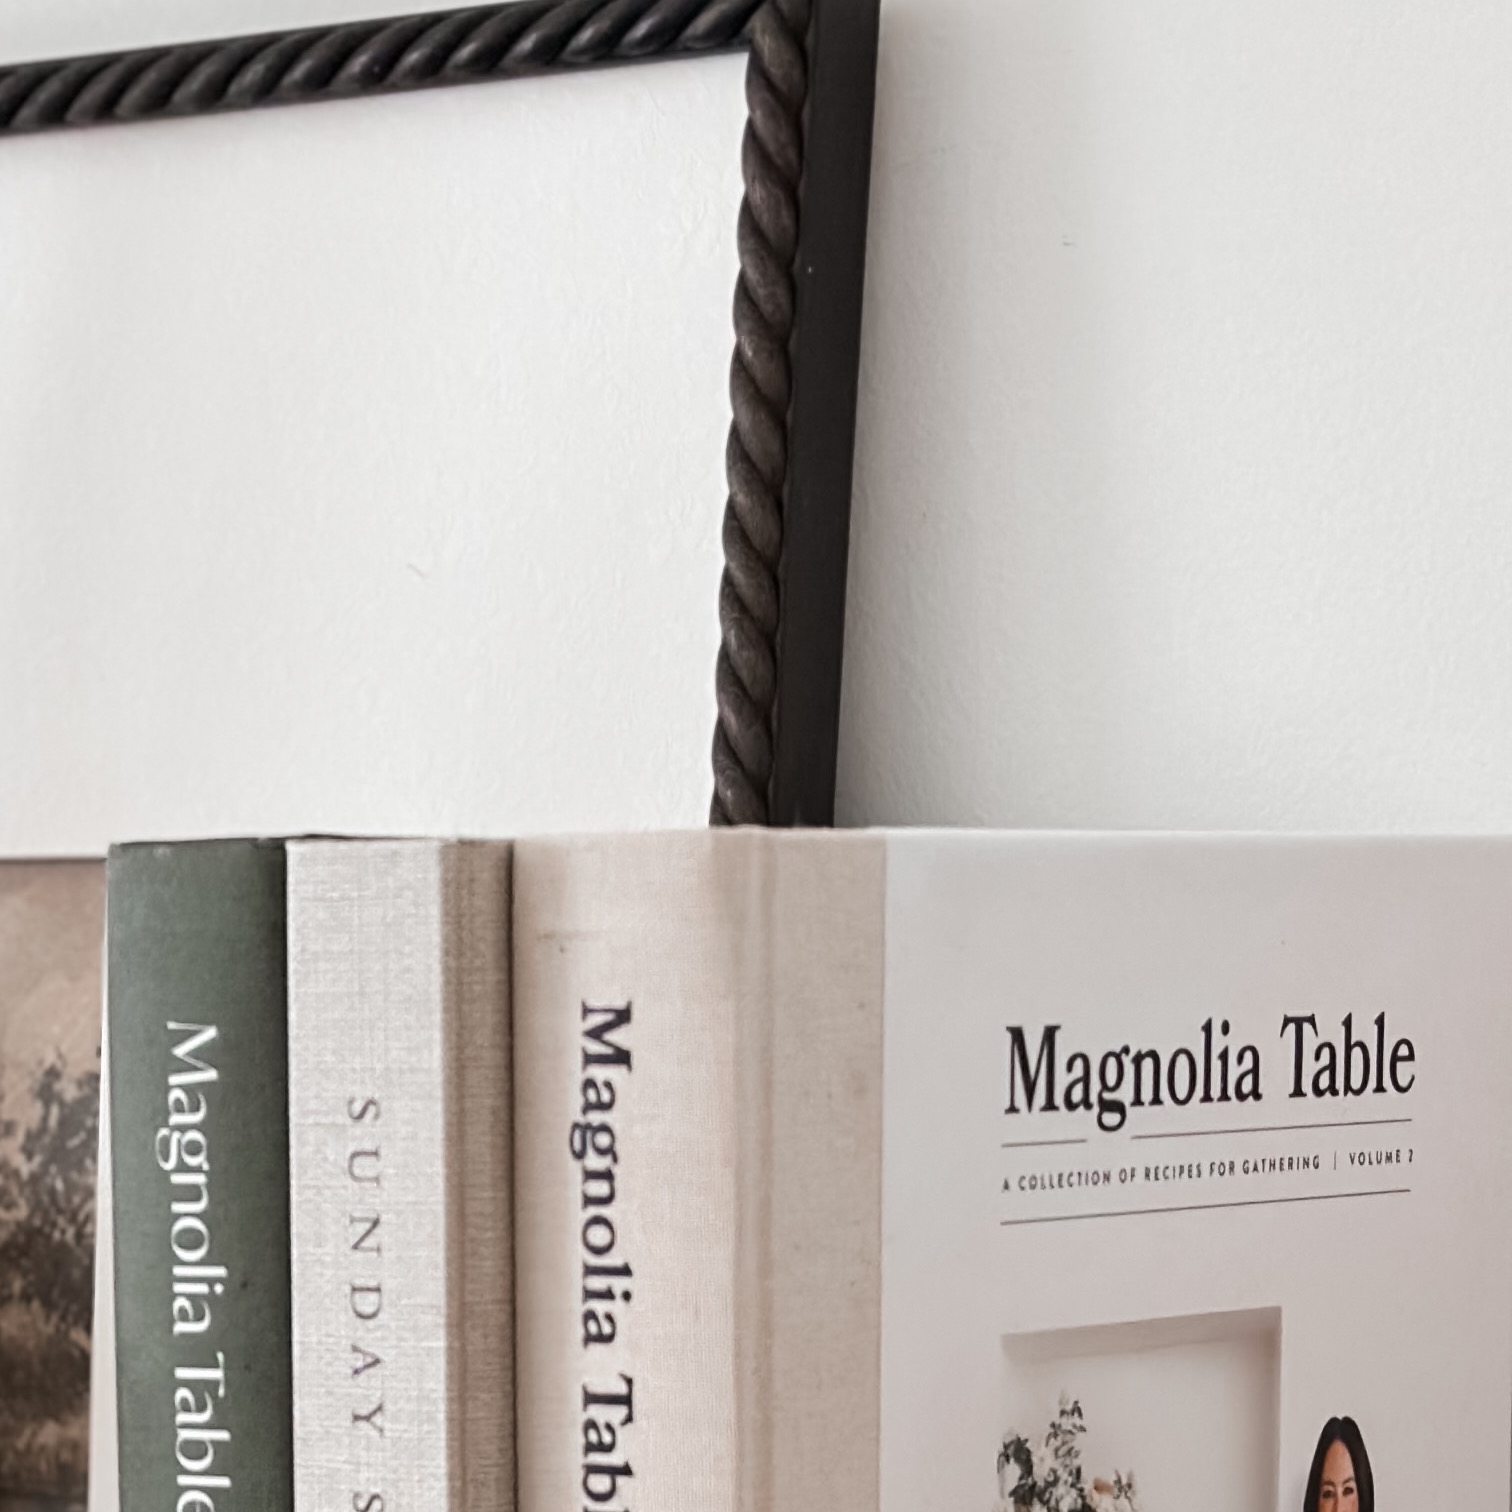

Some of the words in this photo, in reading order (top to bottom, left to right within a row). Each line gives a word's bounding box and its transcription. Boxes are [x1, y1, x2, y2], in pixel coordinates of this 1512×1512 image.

[155, 1020, 226, 1336] Magnolia
[569, 1001, 633, 1349] Magnolia
[1003, 1177, 1010, 1193] A
[1017, 1169, 1111, 1192] COLLECTION
[1118, 1167, 1137, 1184] OF
[1144, 1163, 1203, 1182] RECIPES
[1209, 1160, 1236, 1177] FOR
[1242, 1154, 1321, 1175] GATHERING
[1349, 1150, 1402, 1167] VOLUME
[1004, 1017, 1263, 1132] Magnolia
[1280, 1011, 1416, 1099] Table
[347, 1097, 385, 1441] SUNDAY
